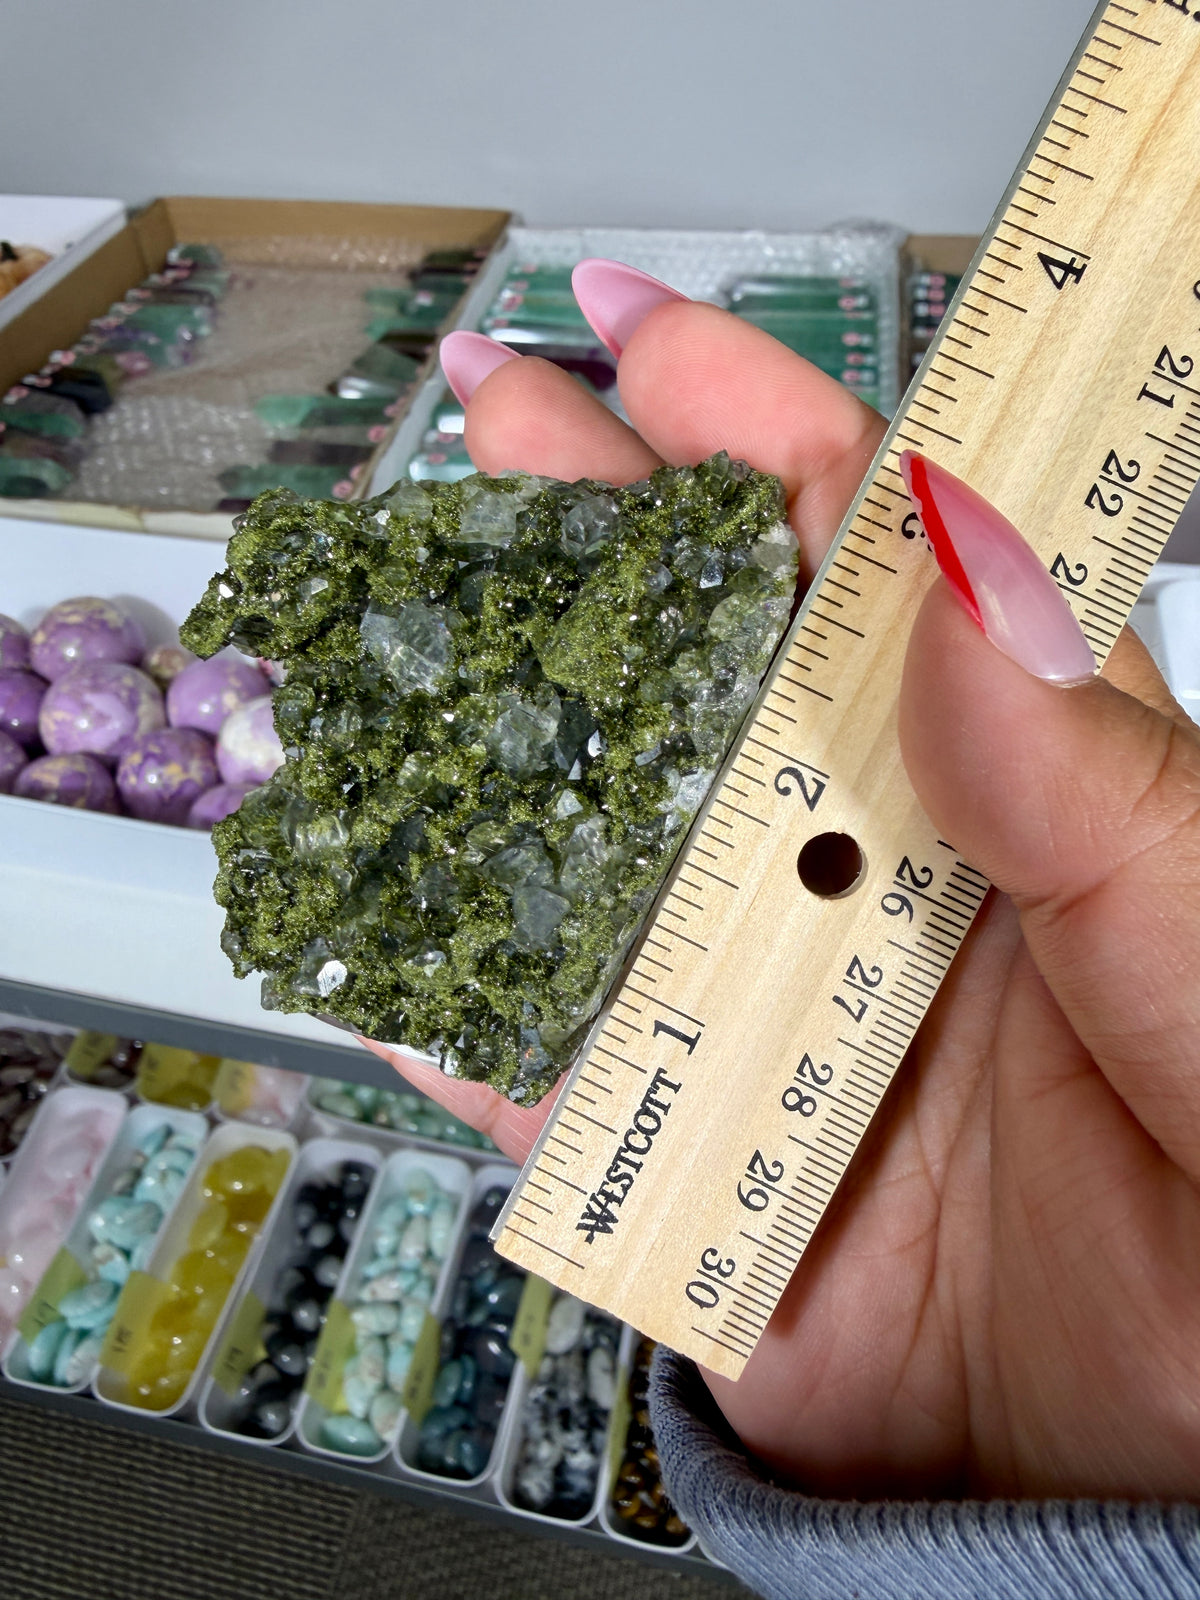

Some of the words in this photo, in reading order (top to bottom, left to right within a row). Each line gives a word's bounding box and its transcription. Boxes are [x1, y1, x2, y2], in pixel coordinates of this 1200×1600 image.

[1037, 252, 1088, 290] 4
[1137, 345, 1194, 408] 21
[1084, 449, 1141, 517] 22
[1050, 552, 1088, 587] 2
[774, 766, 827, 812] 2
[880, 855, 934, 923] 26
[832, 954, 884, 1024] 27
[652, 1019, 702, 1056] 1
[781, 1052, 834, 1118] 28
[575, 1067, 683, 1245] WESTCOTT
[737, 1149, 785, 1212] 29
[685, 1247, 736, 1309] 30
